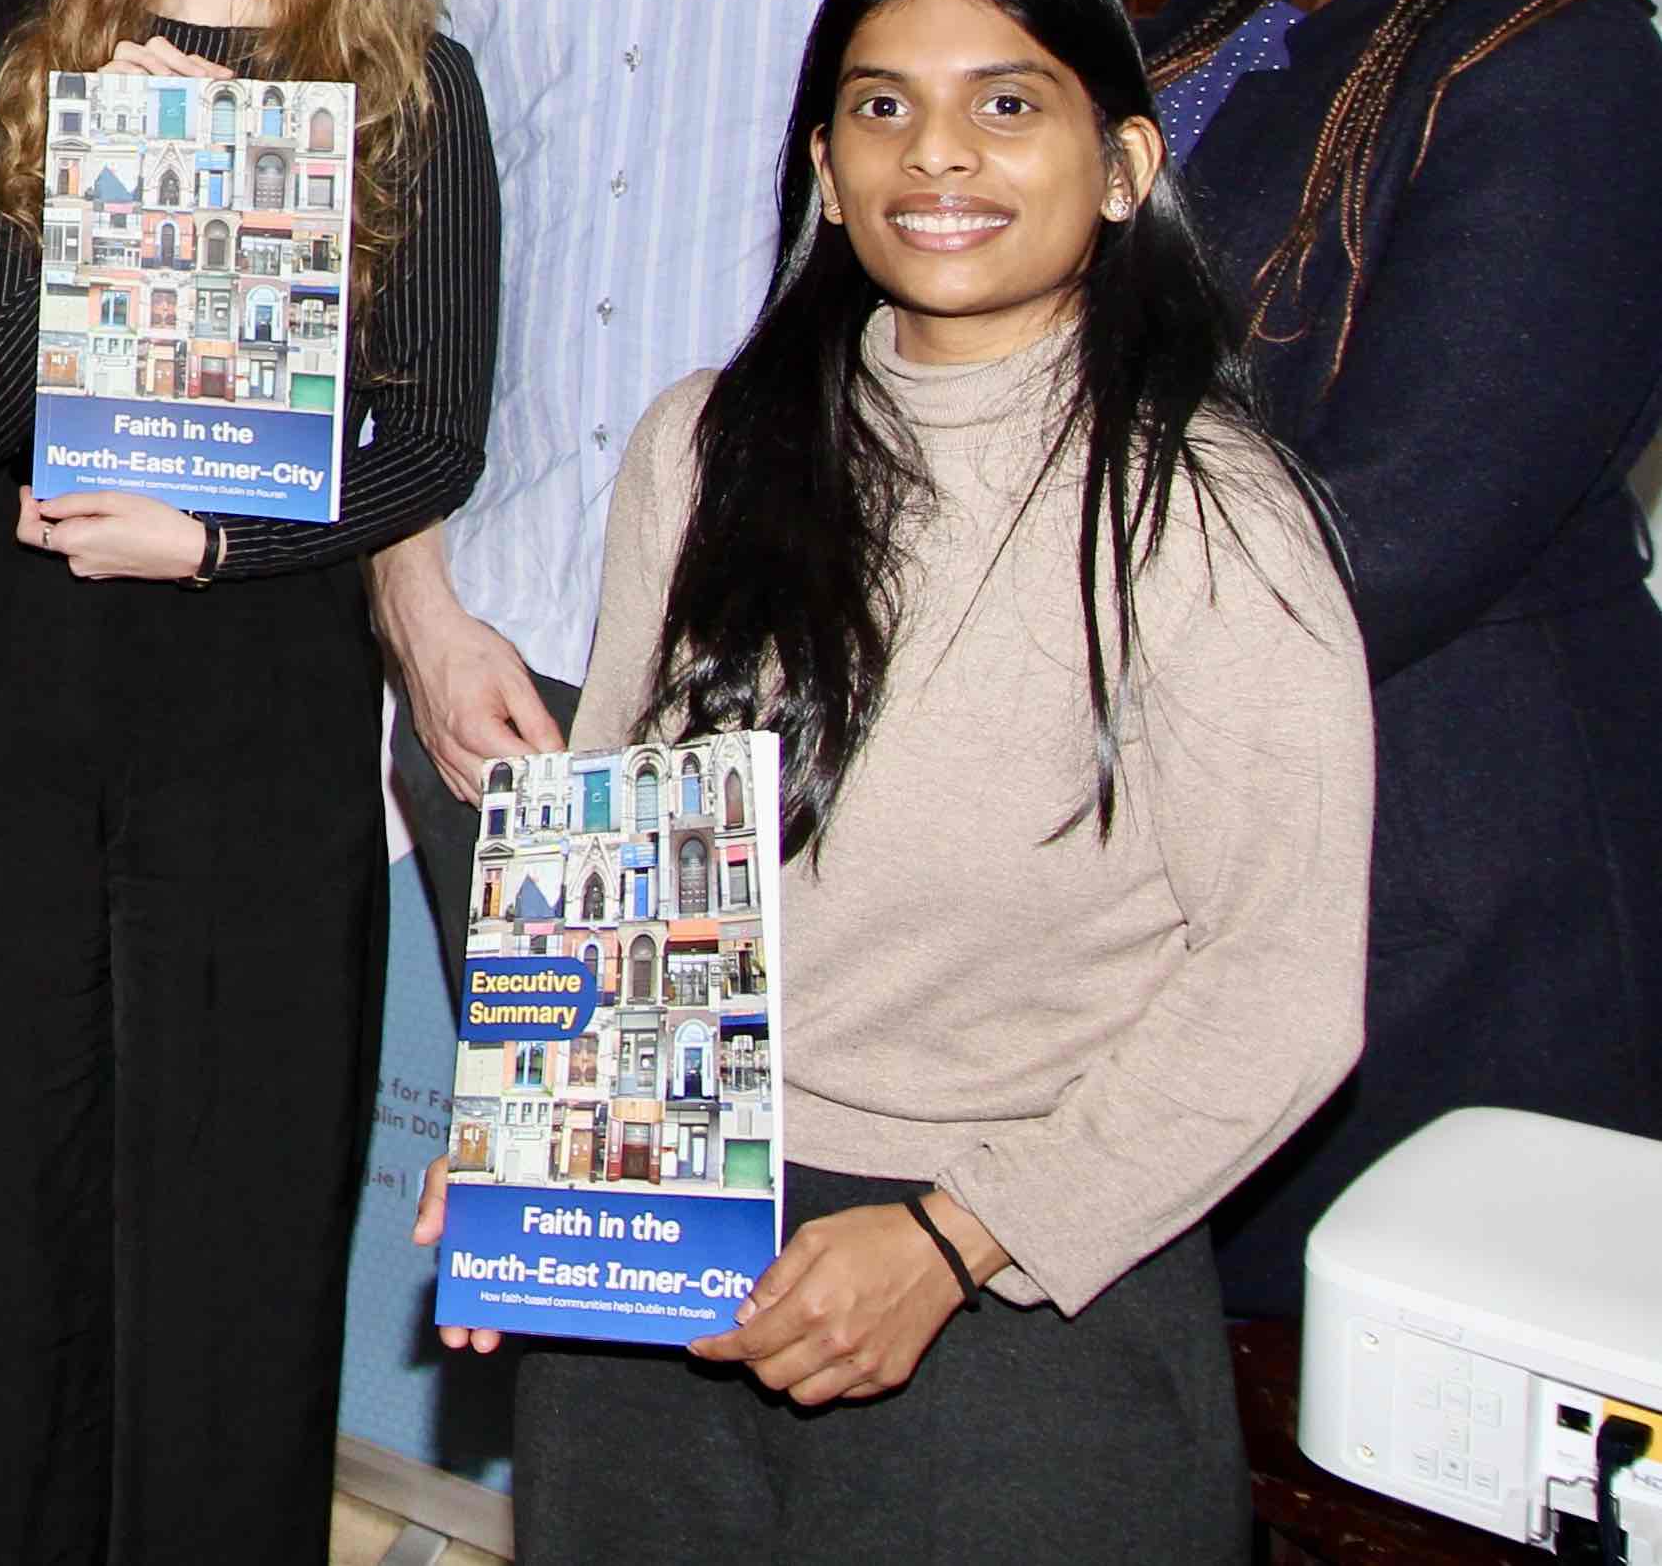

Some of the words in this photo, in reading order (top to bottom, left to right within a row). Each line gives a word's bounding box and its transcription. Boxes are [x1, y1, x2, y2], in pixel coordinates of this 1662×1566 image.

[114, 414, 177, 437] Faith
[183, 419, 206, 441] in
[211, 421, 254, 444] the
[46, 445, 185, 475] North-East
[191, 456, 324, 491] Inner-City
[472, 970, 581, 993] Executive
[470, 1001, 577, 1030] Summary
[391, 1077, 419, 1102] for
[523, 1206, 592, 1237] Faith
[598, 1211, 625, 1239] in
[631, 1212, 680, 1243] the
[451, 1251, 599, 1287] North-East
